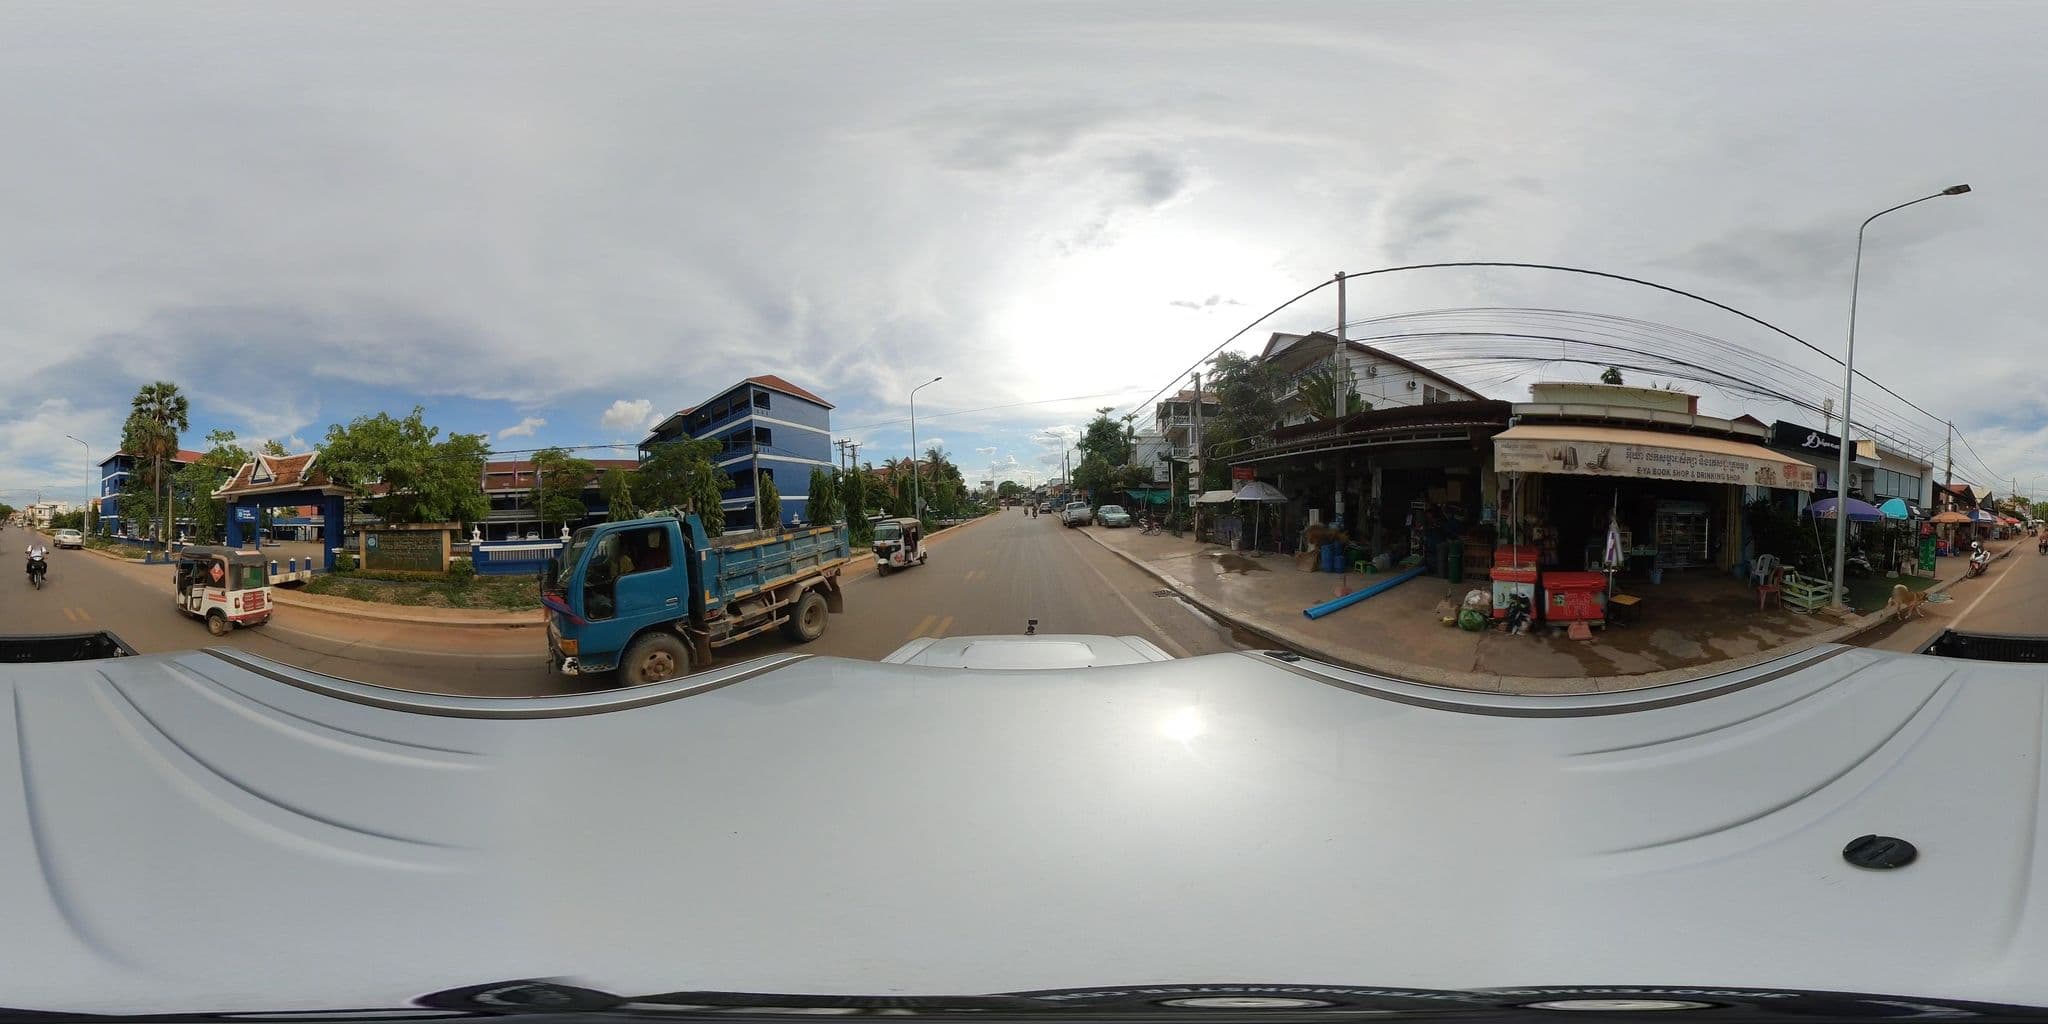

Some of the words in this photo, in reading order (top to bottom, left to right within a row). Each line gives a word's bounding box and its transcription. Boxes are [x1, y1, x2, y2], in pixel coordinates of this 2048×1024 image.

[1652, 467, 1671, 476] BOOK
[1672, 469, 1689, 478] SHOP
[1696, 471, 1725, 480] DRINKING
[1726, 473, 1741, 482] SHOP
